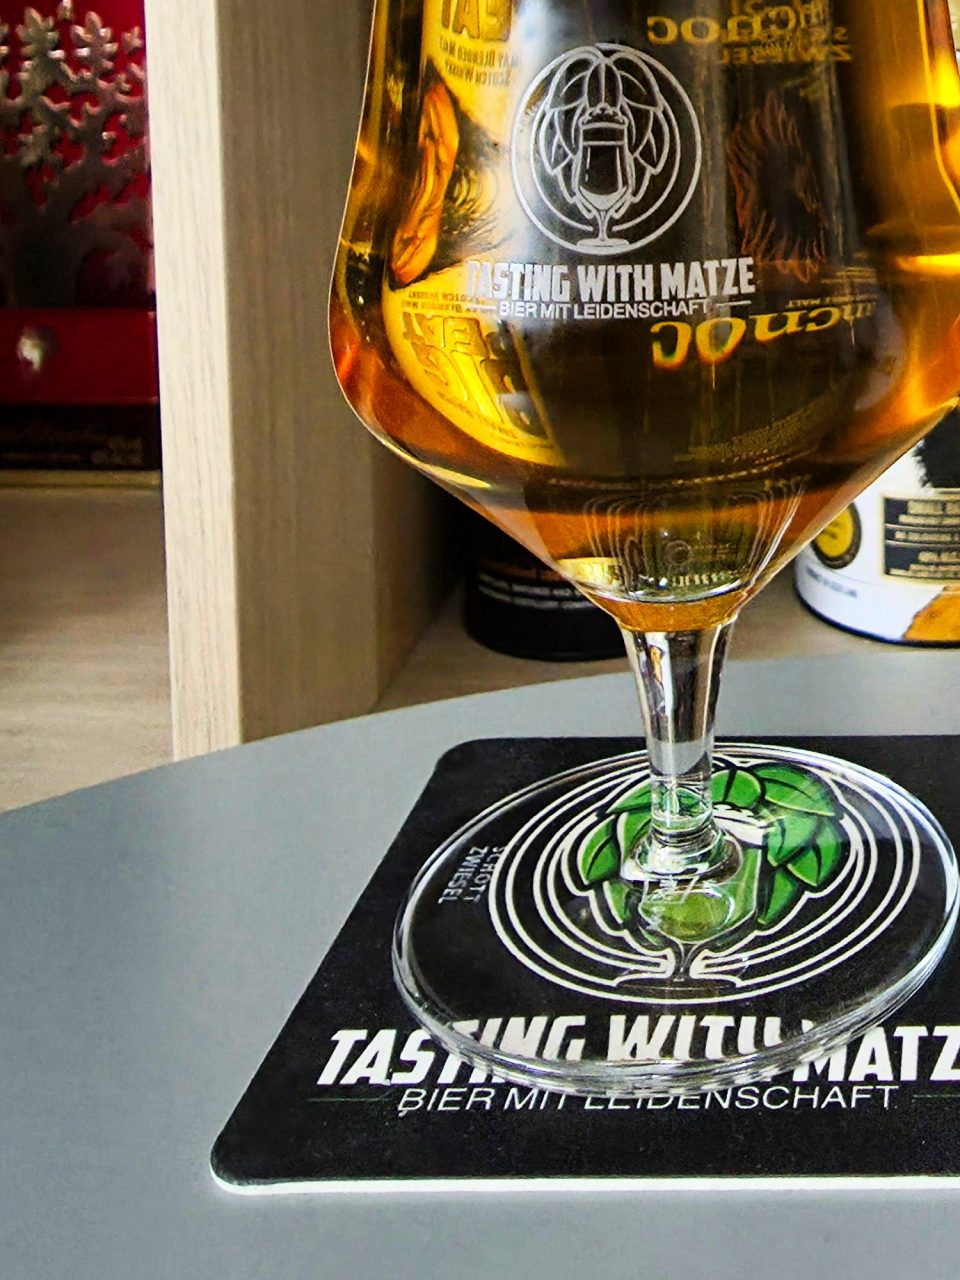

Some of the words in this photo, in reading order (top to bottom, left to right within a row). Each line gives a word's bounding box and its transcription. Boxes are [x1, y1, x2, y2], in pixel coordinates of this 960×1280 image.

[467, 261, 570, 302] TASTING
[577, 264, 654, 302] WITH
[661, 257, 756, 299] MATZE
[499, 300, 537, 319] BIER
[540, 300, 570, 319] MIT
[573, 297, 711, 320] LEIDENSCHAFT
[398, 1087, 495, 1113] BIER
